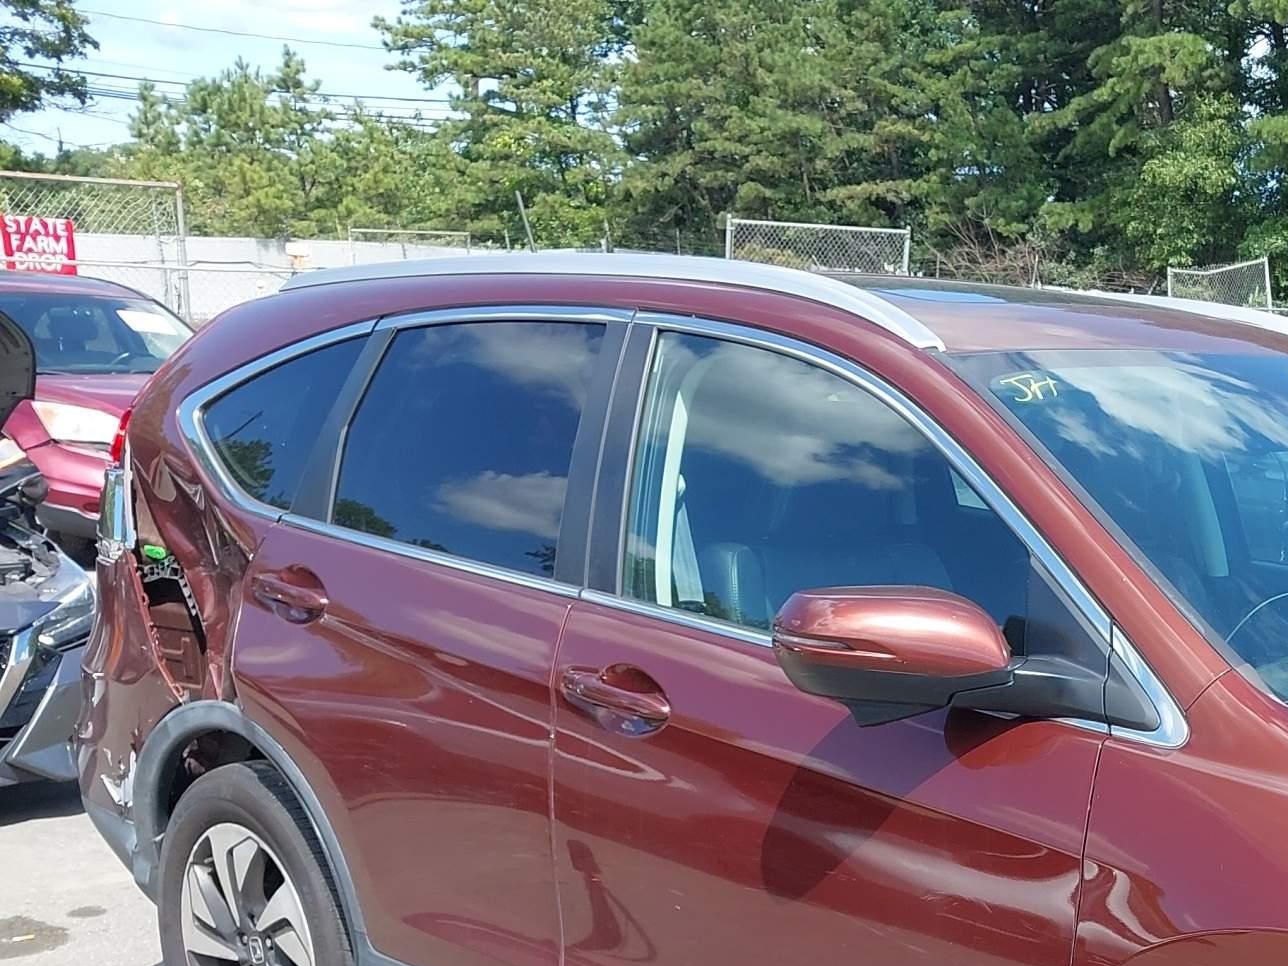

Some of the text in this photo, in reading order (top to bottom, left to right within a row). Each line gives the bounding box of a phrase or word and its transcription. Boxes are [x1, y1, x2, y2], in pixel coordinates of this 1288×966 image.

[4, 215, 68, 236] STATE
[10, 233, 68, 254] FARM
[14, 252, 68, 272] DROP
